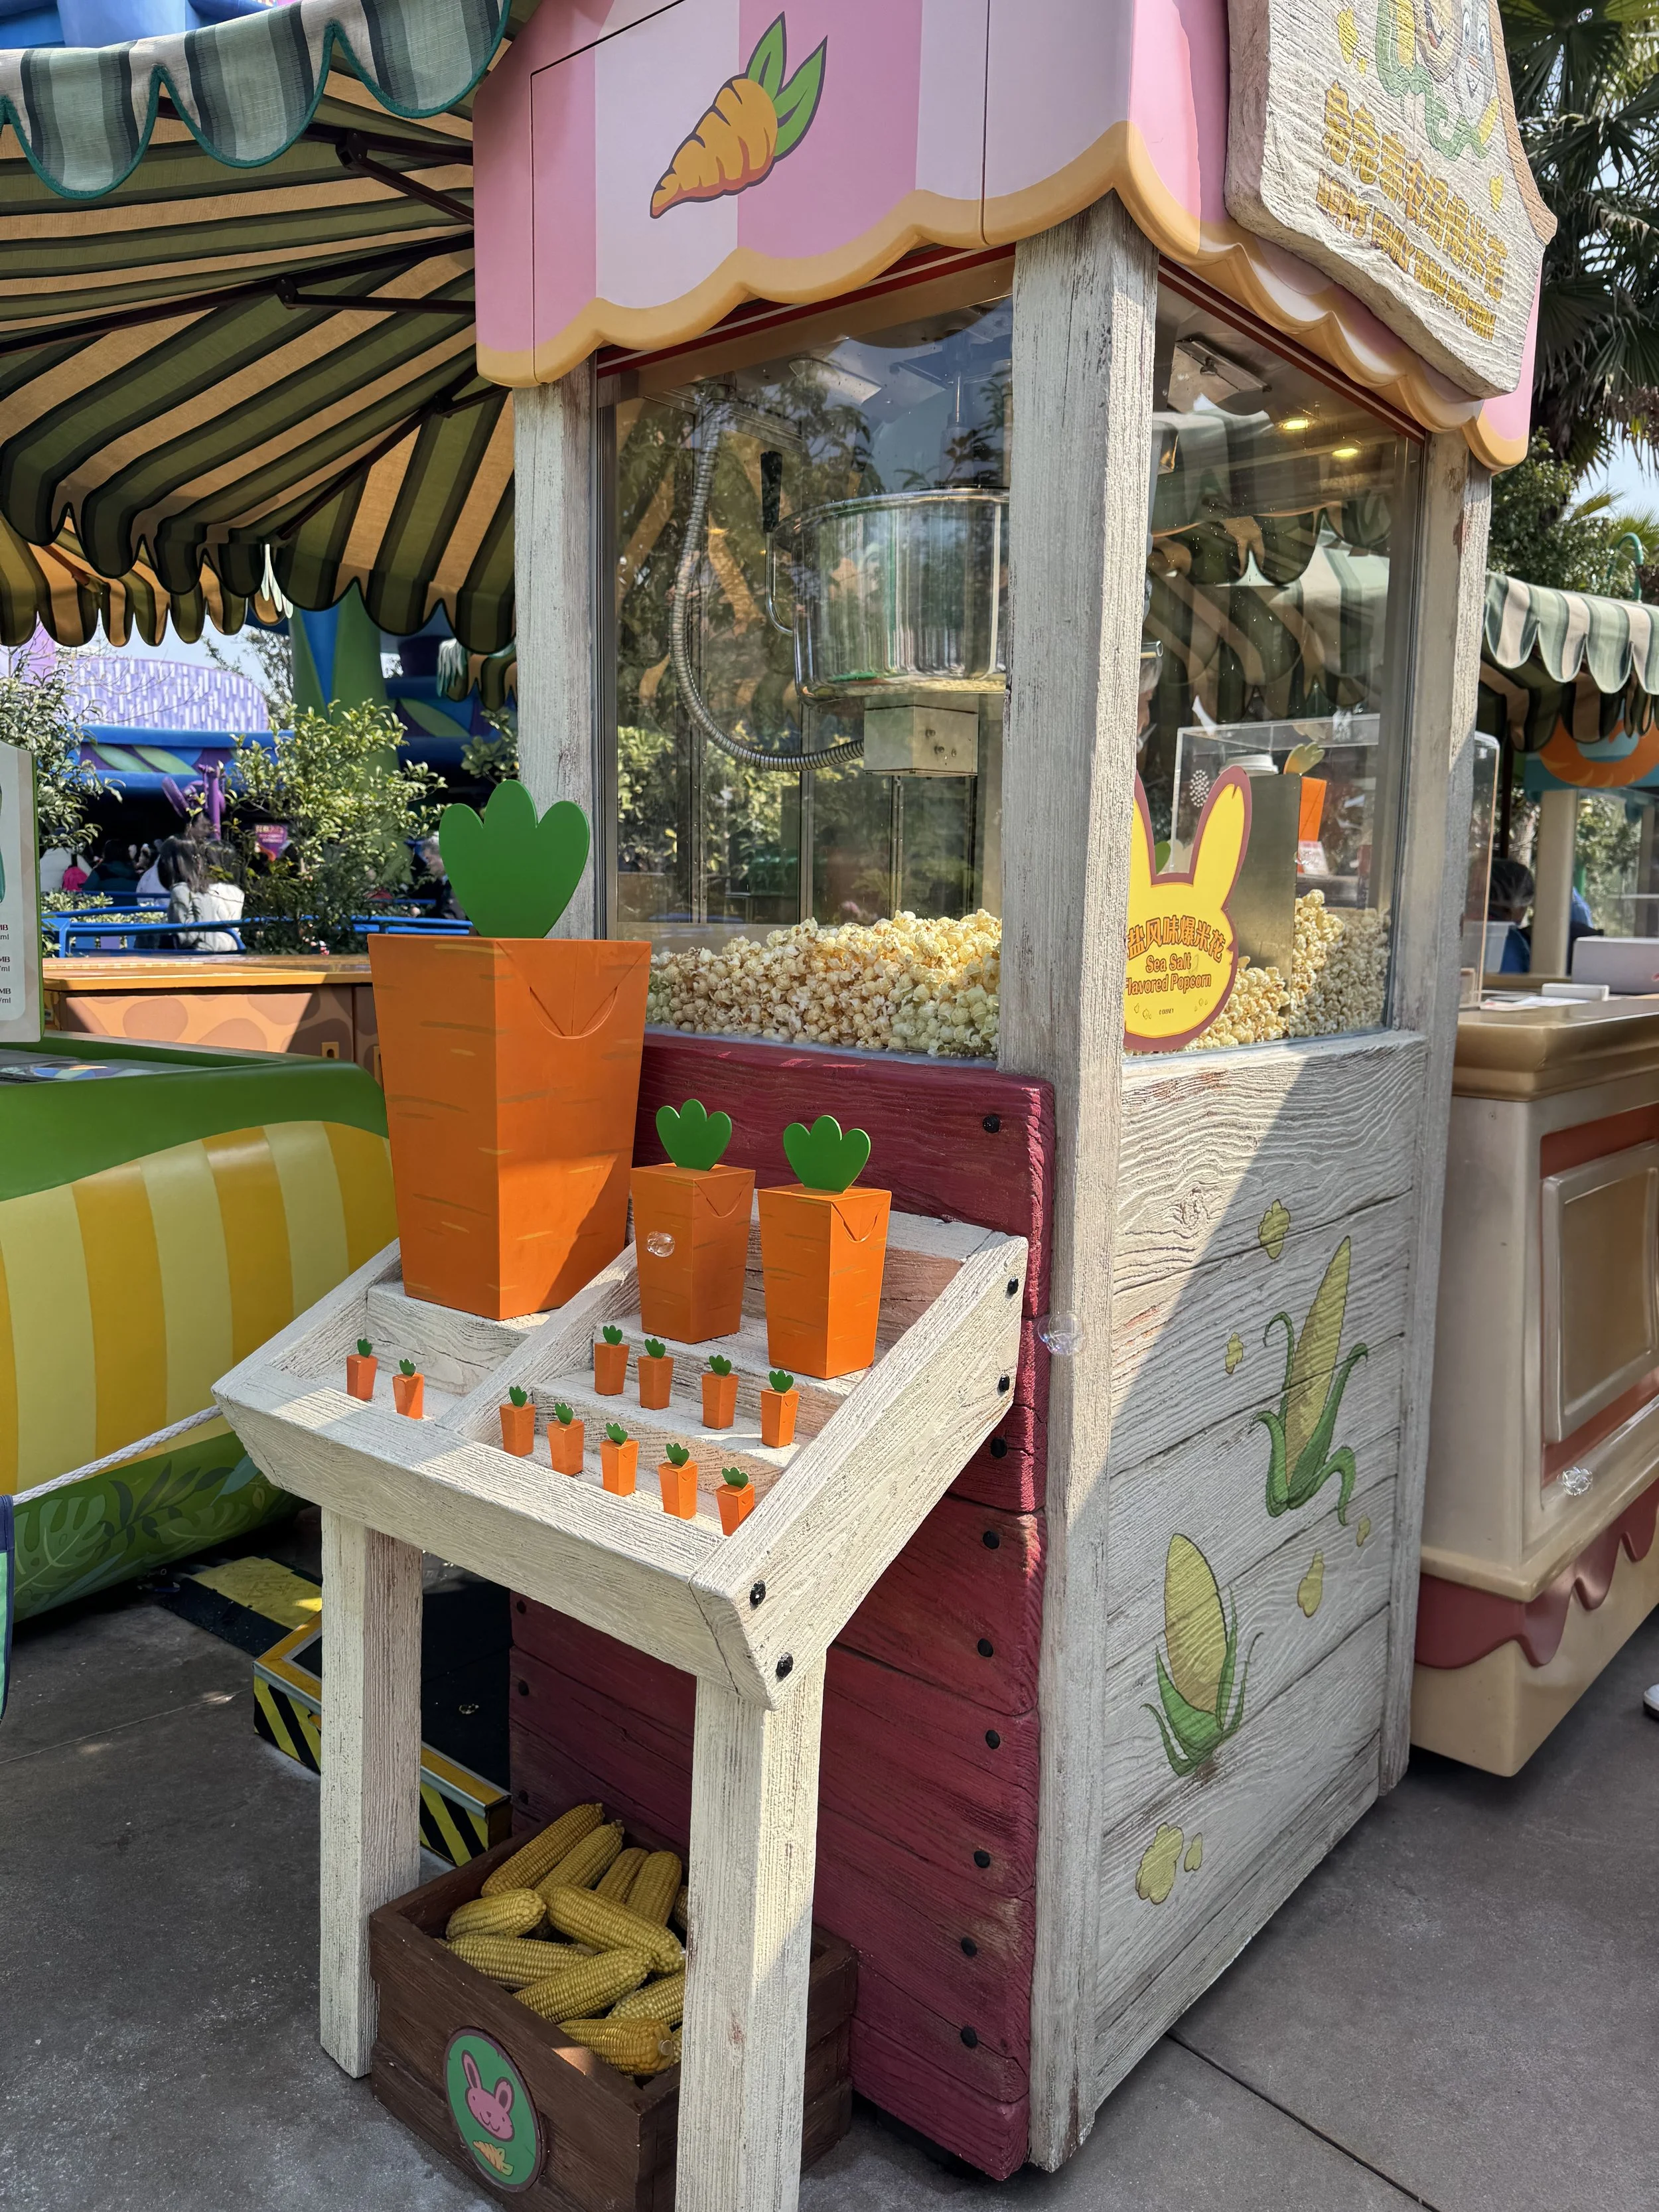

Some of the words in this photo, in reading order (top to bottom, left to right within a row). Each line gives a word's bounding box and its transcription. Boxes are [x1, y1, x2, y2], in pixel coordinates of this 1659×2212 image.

[1370, 208, 1415, 272] FAMILY
[1413, 248, 1449, 299] FARM
[1446, 275, 1497, 341] POPCORN
[1126, 915, 1226, 962] 盐风味爆米花
[1145, 954, 1167, 973] Sea
[1169, 952, 1192, 971] Salt
[1171, 973, 1212, 994] Popcorn
